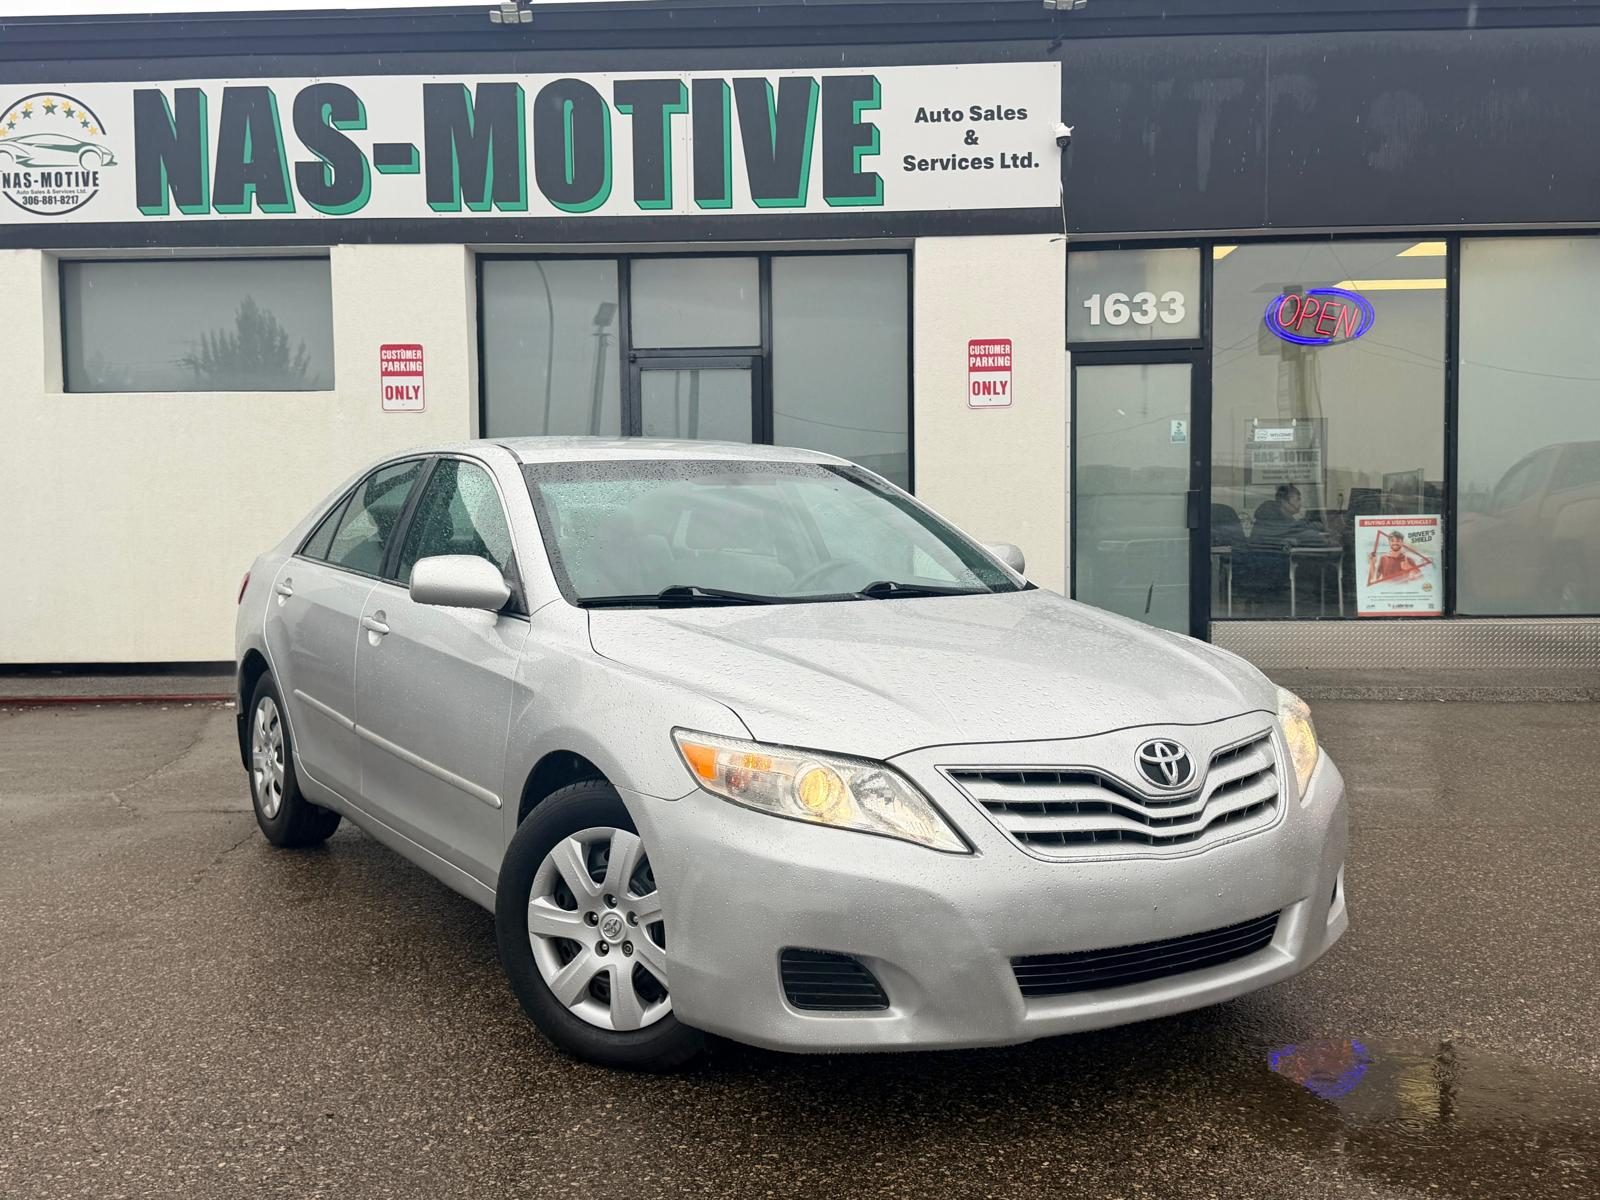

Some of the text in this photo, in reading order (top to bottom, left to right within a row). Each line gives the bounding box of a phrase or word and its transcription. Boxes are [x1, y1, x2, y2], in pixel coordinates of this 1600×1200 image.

[914, 105, 1028, 123] Auto Sales
[133, 74, 885, 216] NAS-MOTIVE
[963, 129, 979, 146] &
[903, 152, 1040, 171] Services Ltd.
[2, 171, 100, 189] NAS-MOTIVE
[22, 195, 79, 205] 306-881-8217
[1083, 291, 1186, 326] 1633
[1278, 294, 1359, 338] OPEN
[381, 349, 422, 360] CUSTOMER
[969, 344, 1011, 355] CUSTOMER
[382, 361, 423, 372] PARKING
[969, 356, 1011, 367] PARKING
[385, 385, 420, 401] ONLY
[972, 380, 1008, 396] ONLY
[1408, 530, 1435, 538] DRIVER'S
